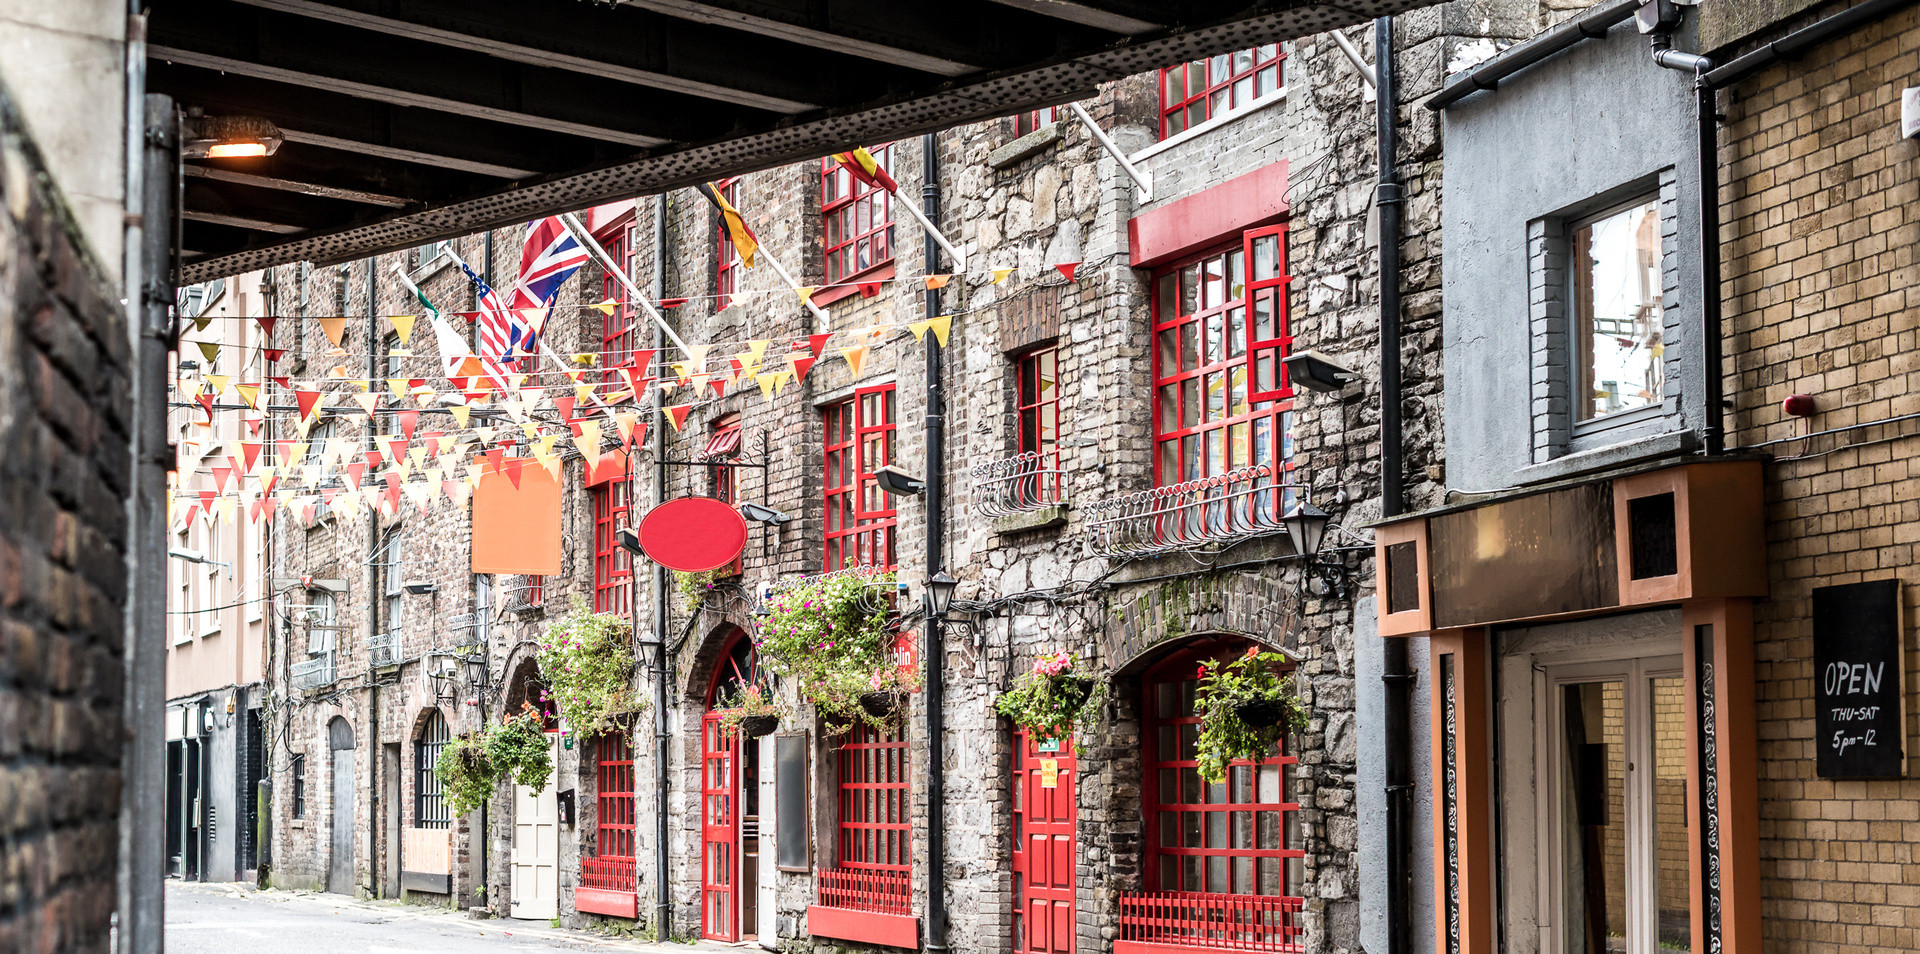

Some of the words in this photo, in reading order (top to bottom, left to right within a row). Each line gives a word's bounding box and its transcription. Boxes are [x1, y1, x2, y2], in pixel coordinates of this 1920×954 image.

[887, 646, 910, 667] ublin
[1824, 660, 1885, 696] OPEN
[1831, 705, 1880, 722] THU-SAT
[1832, 728, 1877, 757] 5pm-12
